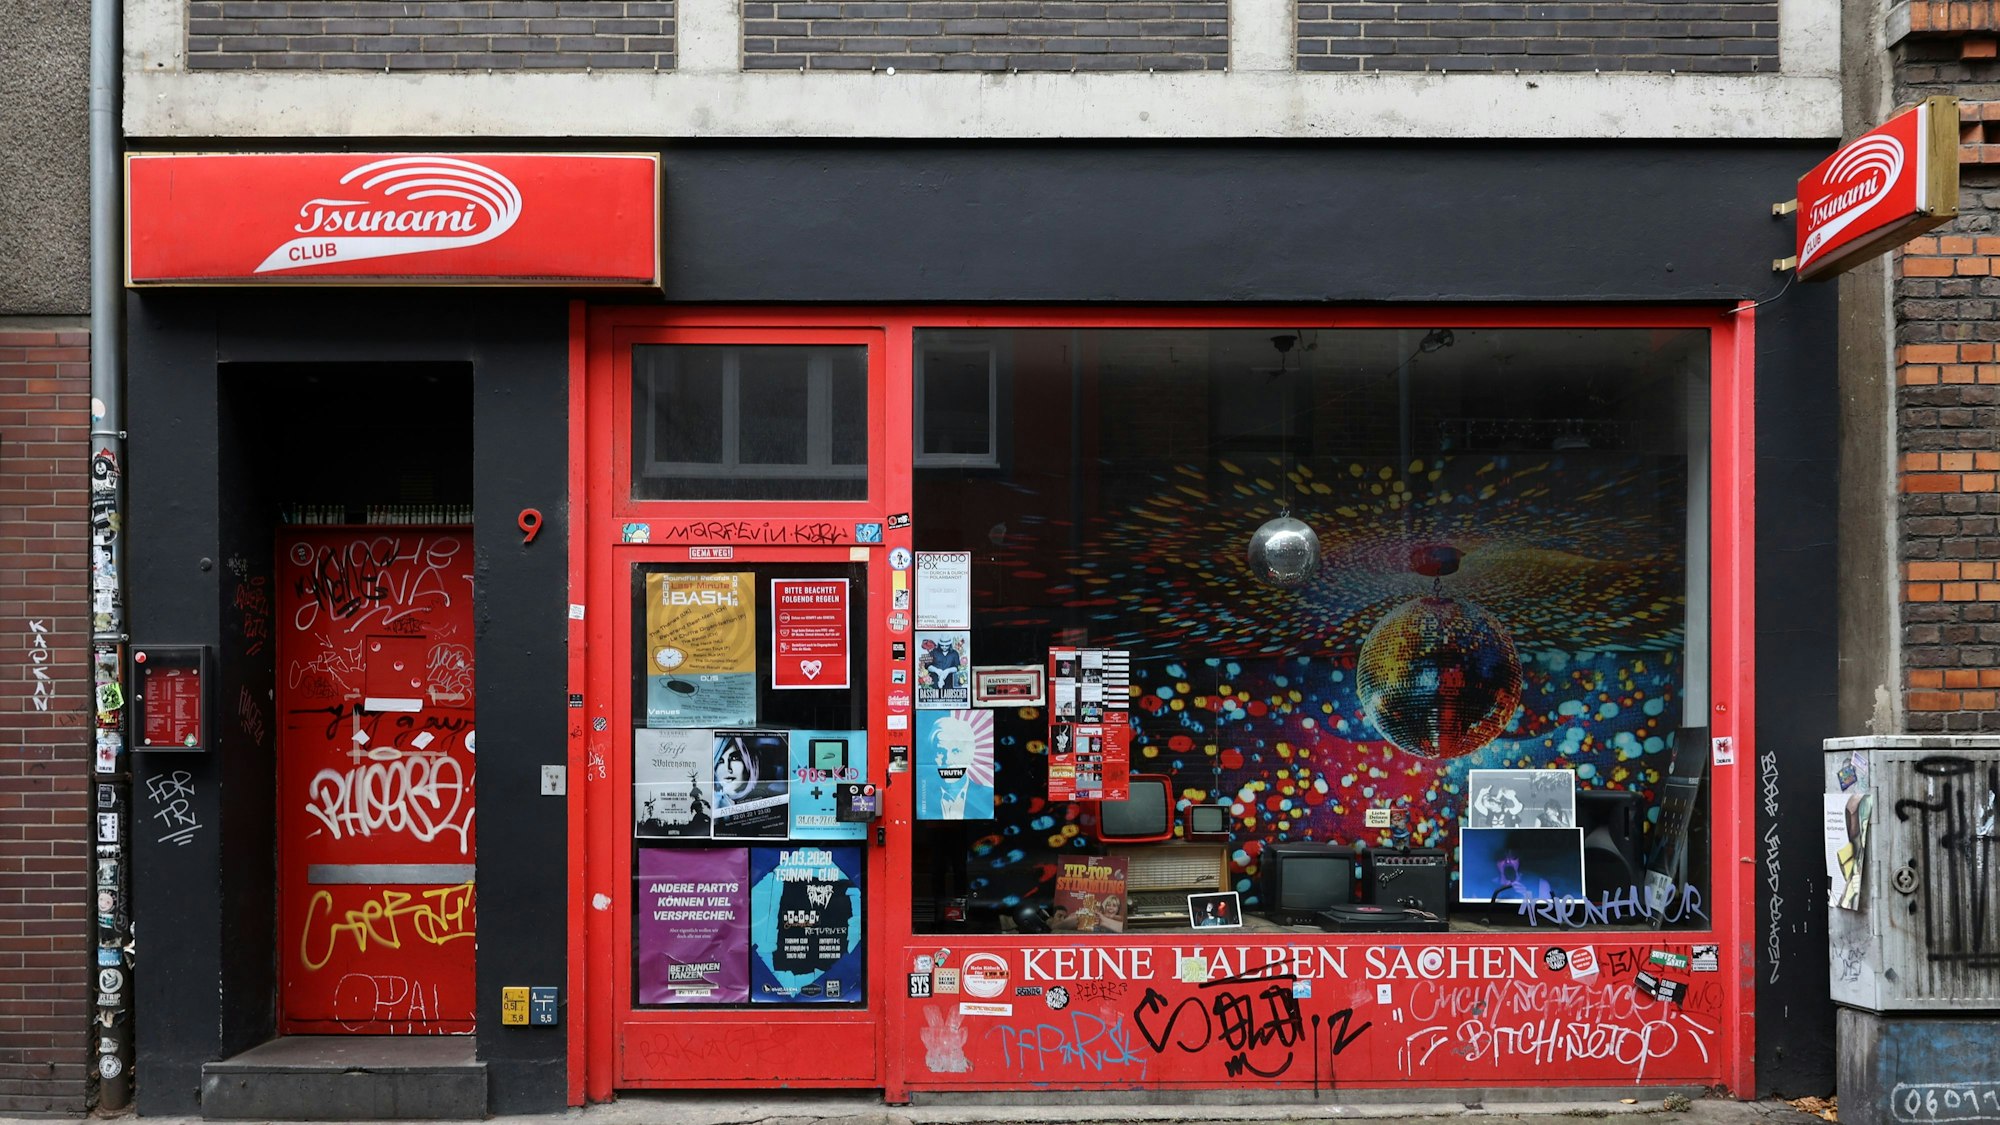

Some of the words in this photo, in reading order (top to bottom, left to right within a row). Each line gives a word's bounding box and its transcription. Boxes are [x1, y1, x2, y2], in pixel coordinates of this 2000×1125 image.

[1807, 169, 1879, 231] Tsunami
[294, 198, 477, 233] Tsunami
[1806, 233, 1822, 255] CLUB
[288, 243, 338, 262] CLUB
[518, 508, 543, 543] 9
[691, 549, 710, 558] GEMA
[712, 549, 731, 558] WEG!
[917, 554, 966, 563] KOMODO
[917, 562, 938, 570] FOX
[784, 586, 802, 594] BITTE
[804, 586, 836, 594] BEACHTET
[671, 590, 732, 606] BASH
[781, 595, 813, 603] FOLGENDE
[816, 595, 839, 603] REGELN
[831, 765, 859, 782] KID
[779, 850, 832, 866] 19.03.2020
[775, 868, 813, 882] TSUNAMI
[818, 868, 840, 882] CLUB
[1064, 863, 1113, 880] TIP-TOP
[650, 883, 695, 893] ANDERE
[696, 883, 738, 893] PARTYS
[1056, 876, 1125, 894] STIMMUNG
[658, 896, 704, 907] KÖNNEN
[707, 897, 731, 906] VIEL
[653, 911, 736, 921] VERSPRECHEN.
[670, 963, 720, 973] BETRUNKEN
[1021, 947, 1155, 981] KEINE
[1365, 946, 1539, 980] SACHEN
[671, 971, 703, 980] TANZEN
[911, 975, 930, 994] SYS
[531, 992, 537, 1000] A
[540, 1014, 552, 1023] 5,5
